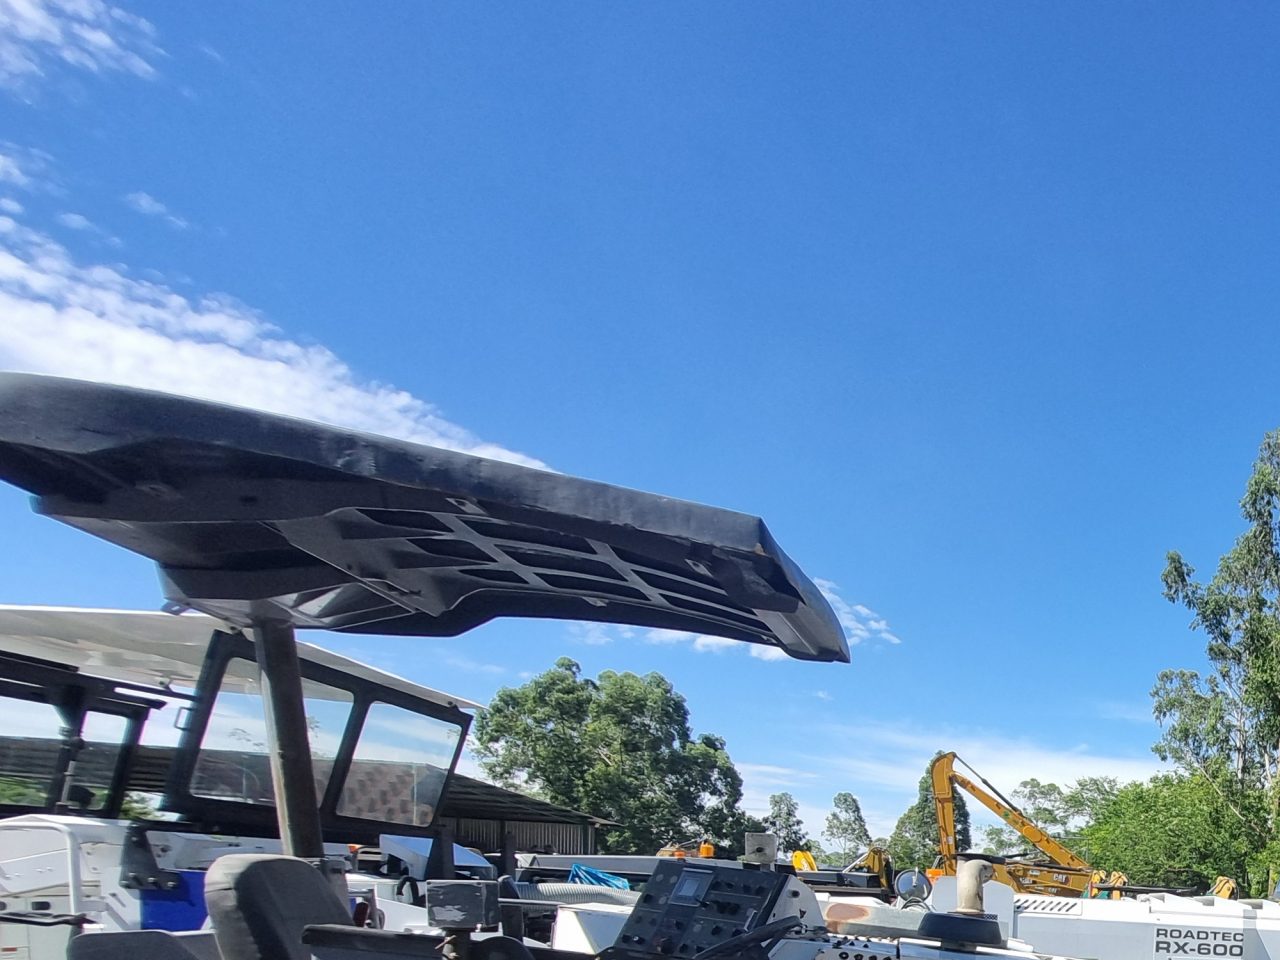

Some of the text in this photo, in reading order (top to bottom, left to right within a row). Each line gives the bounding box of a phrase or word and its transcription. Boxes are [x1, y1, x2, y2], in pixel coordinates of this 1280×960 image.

[1053, 873, 1067, 883] CAT
[1156, 928, 1245, 942] ROADTEC
[1155, 940, 1244, 957] RX-600
